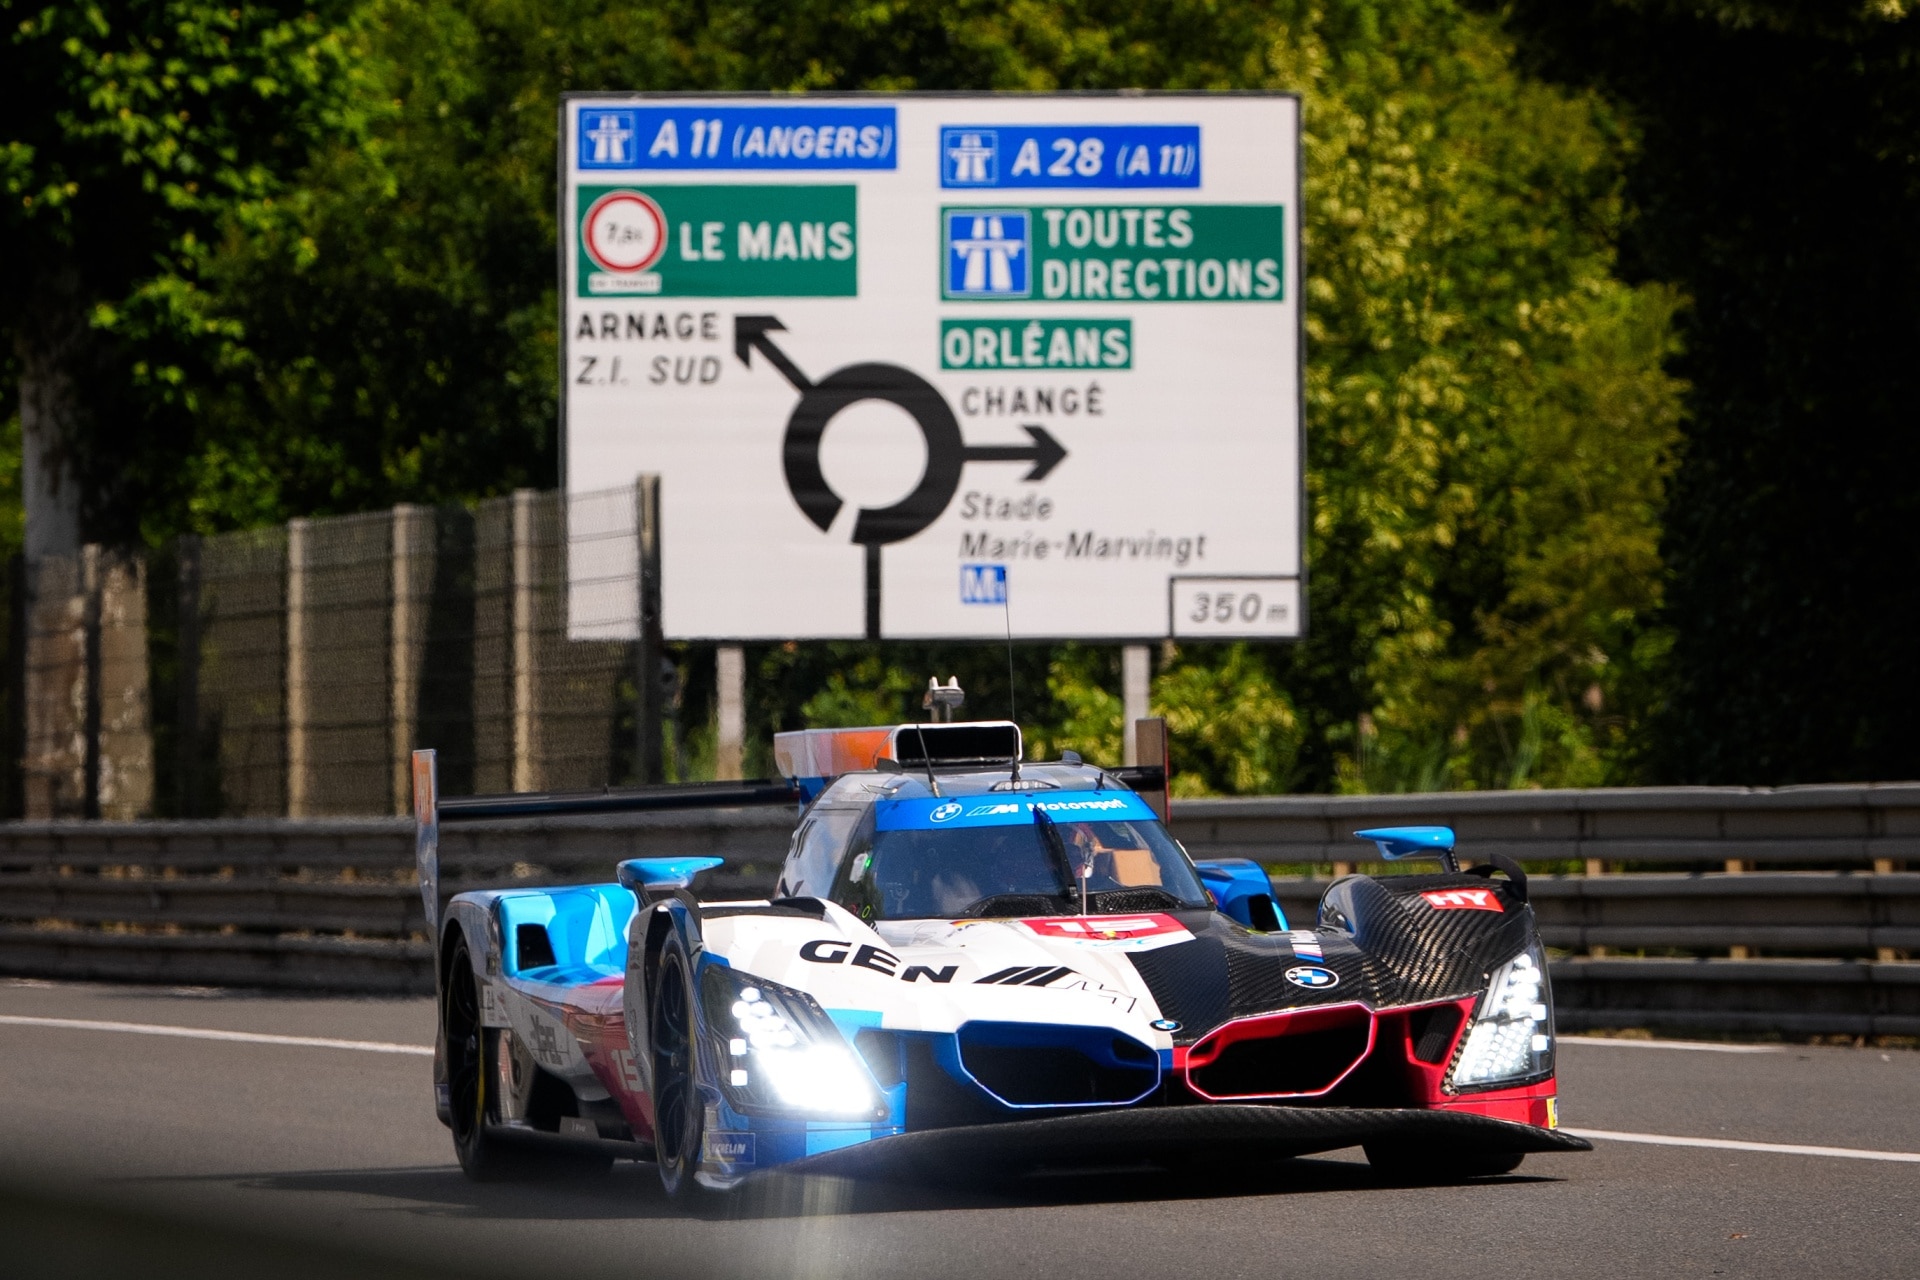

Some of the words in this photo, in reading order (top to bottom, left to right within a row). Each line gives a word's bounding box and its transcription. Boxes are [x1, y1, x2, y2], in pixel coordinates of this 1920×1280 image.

[649, 118, 679, 158] A
[690, 118, 723, 158] 11
[732, 124, 893, 160] (ANGERS)
[1011, 138, 1041, 177] A
[1046, 138, 1105, 177] 28
[679, 221, 726, 261] LE
[737, 221, 855, 261] MANS
[1043, 208, 1194, 248] TOUTES
[1043, 258, 1281, 299] DIRECTIONS
[576, 312, 720, 340] ARNAGE
[944, 320, 1130, 367] ORLÉANS
[576, 355, 629, 384] Z.I.
[648, 355, 722, 384] SUD
[960, 382, 1106, 416] CHANGÉ
[960, 491, 1054, 520] Stade
[959, 530, 1207, 567] Marie-Marvingt
[1027, 799, 1128, 813] Motorsport
[1427, 892, 1488, 906] HY
[1045, 918, 1159, 933] 15
[800, 940, 960, 984] GEN
